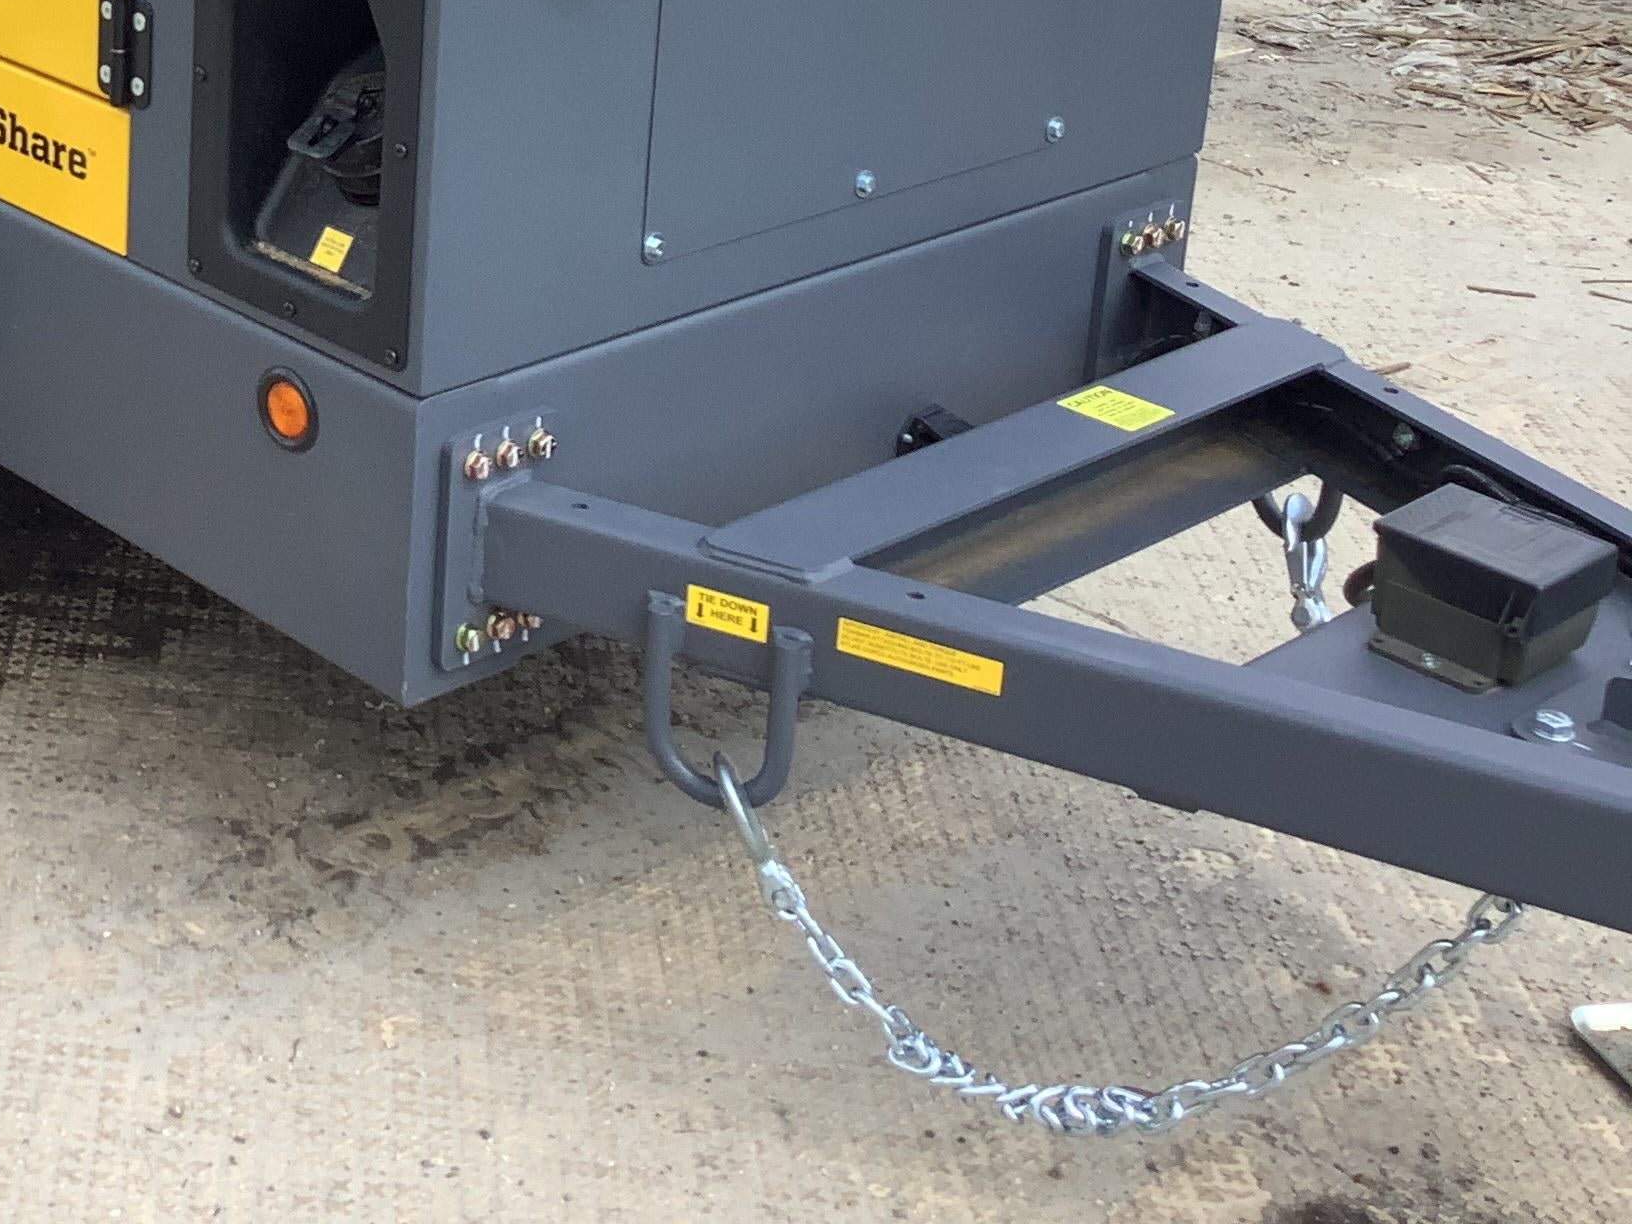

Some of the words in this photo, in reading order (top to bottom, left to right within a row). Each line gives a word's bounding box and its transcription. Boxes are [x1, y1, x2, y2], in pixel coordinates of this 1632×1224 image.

[698, 591, 716, 605] TIE
[719, 597, 758, 617] DOWN
[710, 608, 744, 626] HERE
